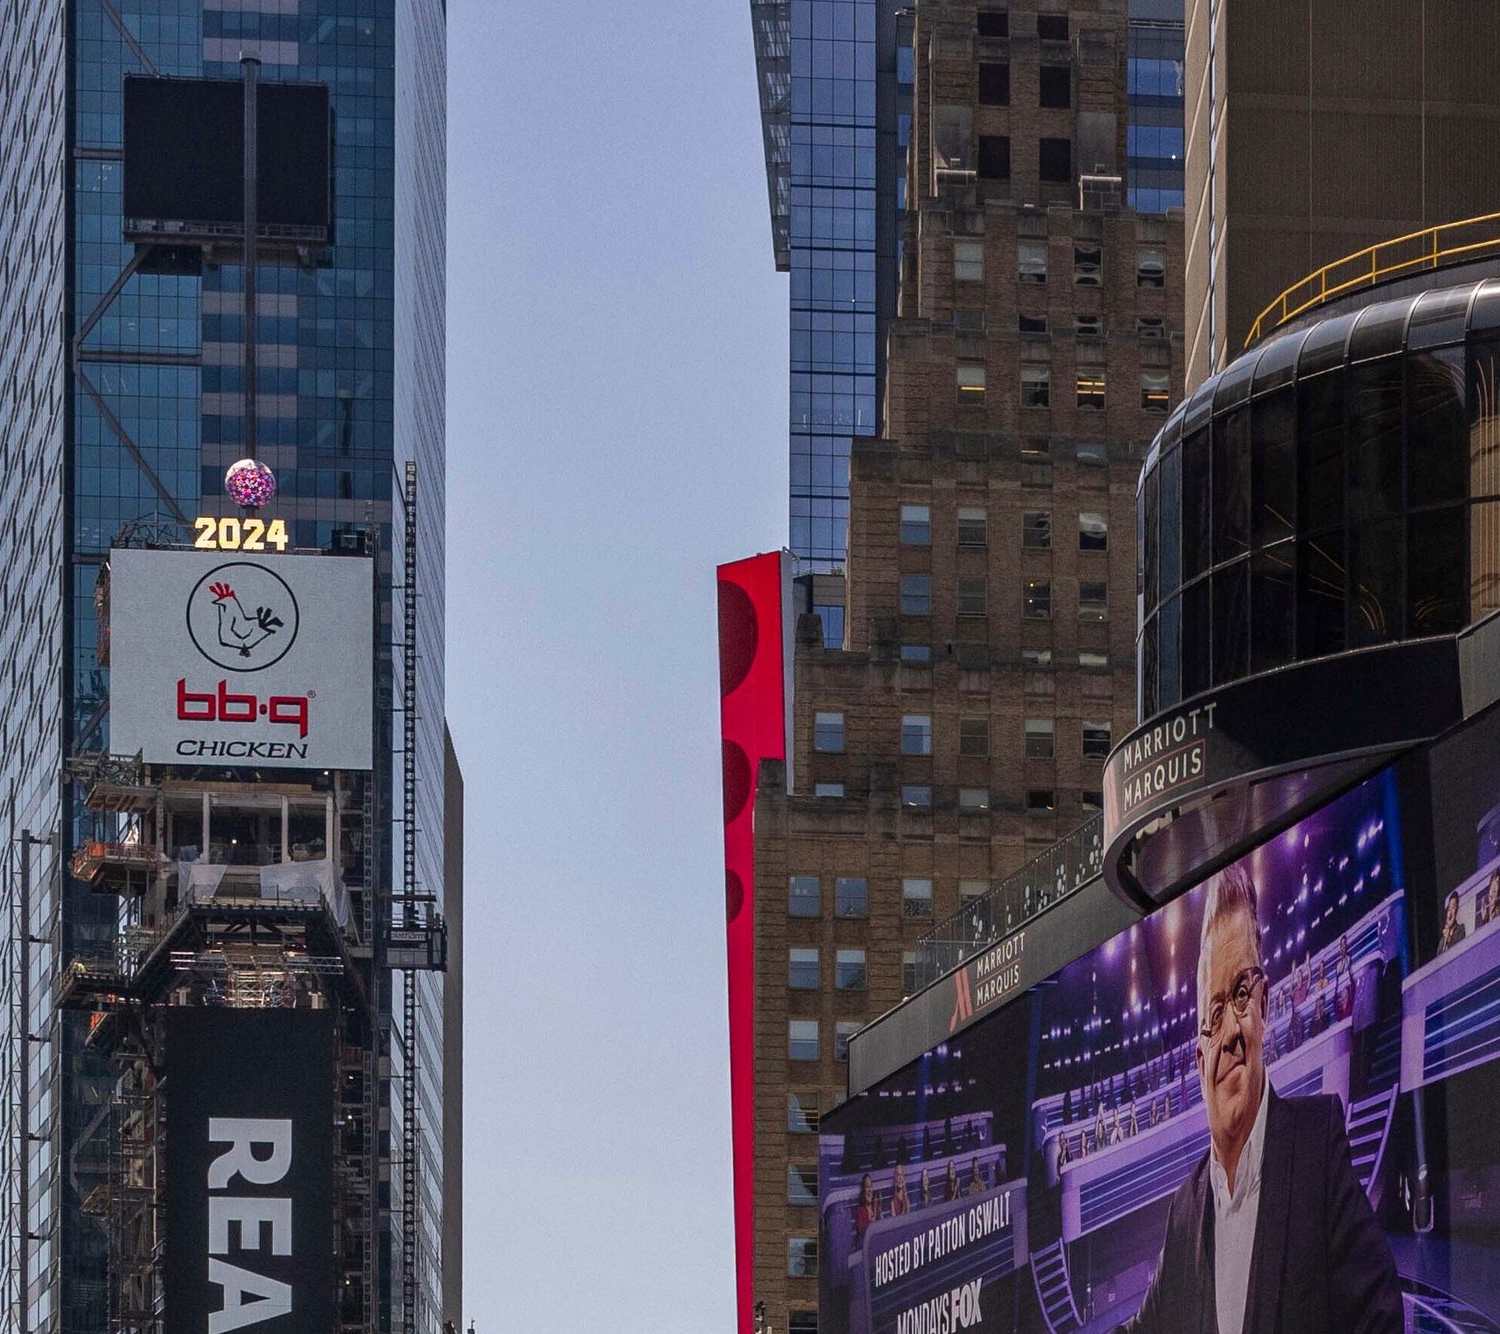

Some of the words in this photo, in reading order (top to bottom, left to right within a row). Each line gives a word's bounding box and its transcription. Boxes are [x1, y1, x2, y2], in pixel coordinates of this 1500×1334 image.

[194, 517, 289, 551] 2024
[176, 740, 308, 760] CHICKEN
[1123, 701, 1217, 775] MARRIOTT
[1123, 747, 1202, 812] MARQUIS
[975, 934, 1026, 978] MARRIOTT
[975, 967, 1021, 1005] MARQUIS
[875, 1245, 911, 1287] HOSTED
[913, 1237, 925, 1270] BY
[928, 1213, 966, 1263] PATTON
[969, 1191, 1011, 1243] OSWALT
[951, 1278, 983, 1334] FOX
